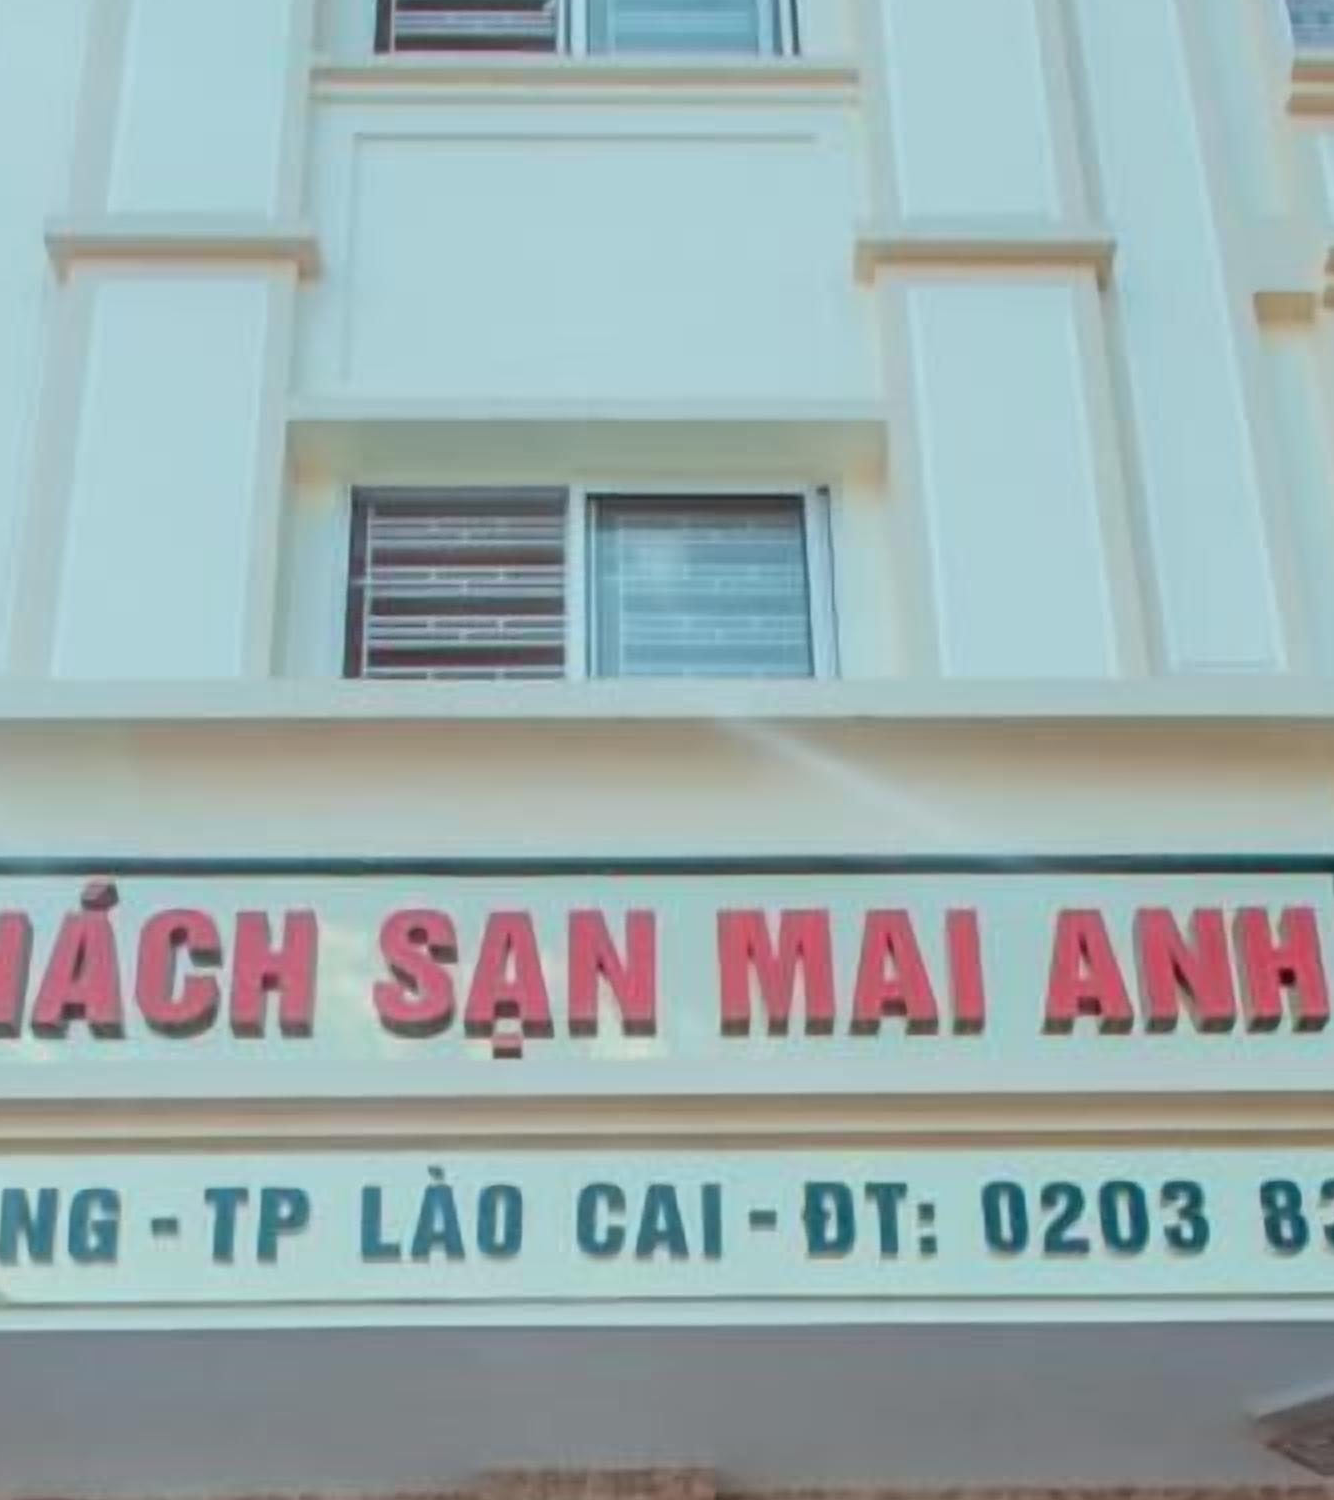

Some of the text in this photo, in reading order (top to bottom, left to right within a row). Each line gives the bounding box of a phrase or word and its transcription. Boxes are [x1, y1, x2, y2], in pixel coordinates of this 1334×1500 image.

[371, 907, 658, 1060] SẠN
[715, 907, 987, 1038] MAI
[1039, 905, 1331, 1037] ANH
[203, 1186, 312, 1265] TP
[360, 1164, 524, 1264] LÀO
[575, 1181, 724, 1261] CAI
[980, 1178, 1212, 1259] 0203
